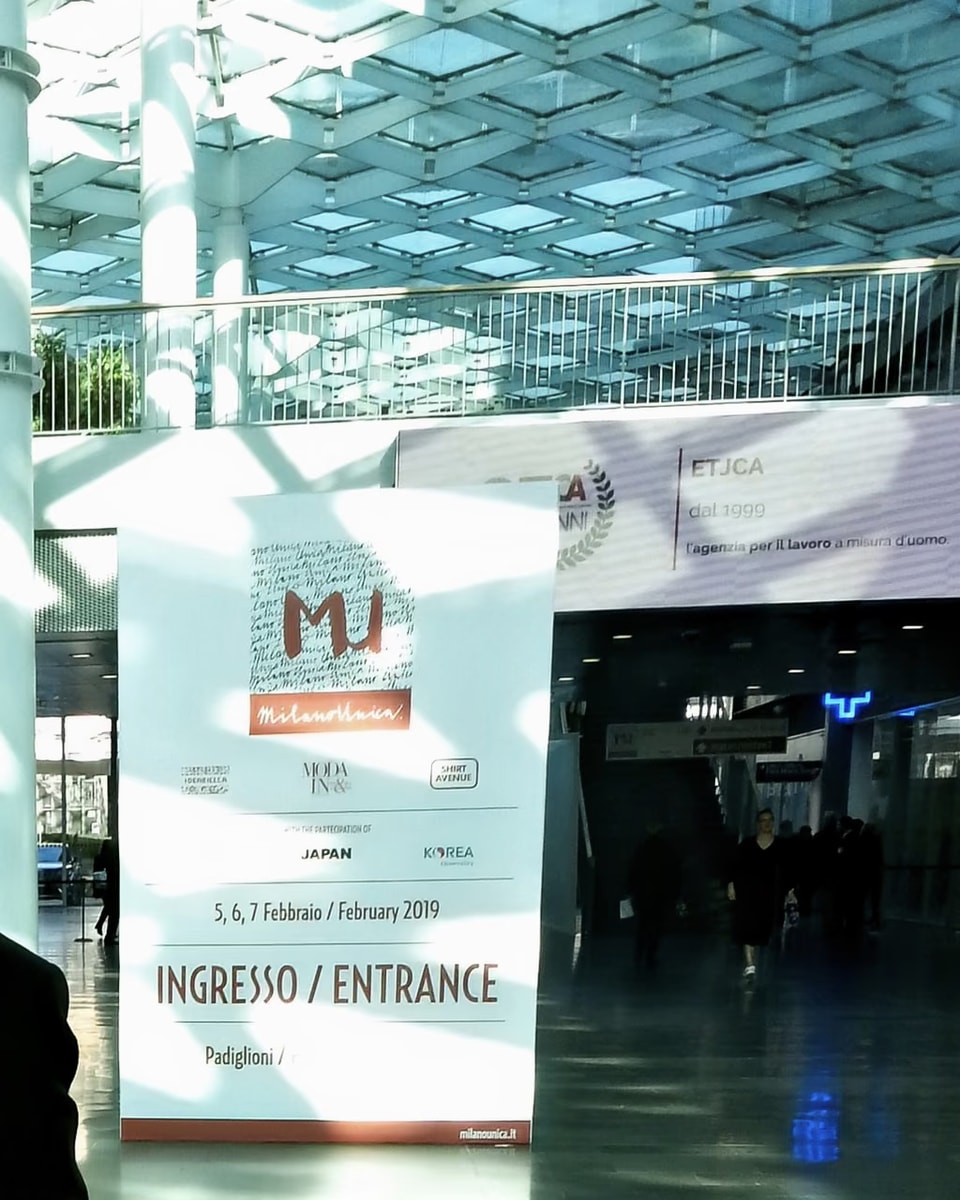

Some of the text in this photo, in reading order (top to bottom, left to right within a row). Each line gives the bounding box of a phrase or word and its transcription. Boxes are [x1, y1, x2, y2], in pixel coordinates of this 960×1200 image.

[691, 457, 764, 478] ETJCA
[689, 503, 765, 519] dal 1999
[749, 543, 772, 554] per
[776, 540, 784, 551] il
[788, 538, 831, 550] lavoro
[835, 540, 843, 549] a
[846, 536, 891, 549] misura
[283, 588, 384, 660] MU
[303, 762, 348, 778] MODA
[435, 772, 472, 783] AVENUE
[441, 765, 468, 774] SHIRT
[301, 848, 352, 860] JAPAN
[423, 846, 474, 859] KOREA
[215, 903, 228, 926] 5,
[232, 903, 246, 925] 6,
[250, 903, 258, 921] 7
[264, 901, 322, 921] Febbraio
[339, 900, 399, 924] February
[403, 900, 440, 920] 2019
[157, 963, 498, 1005] INGRESSO / ENTRANCE
[205, 1046, 273, 1069] Padiglioni
